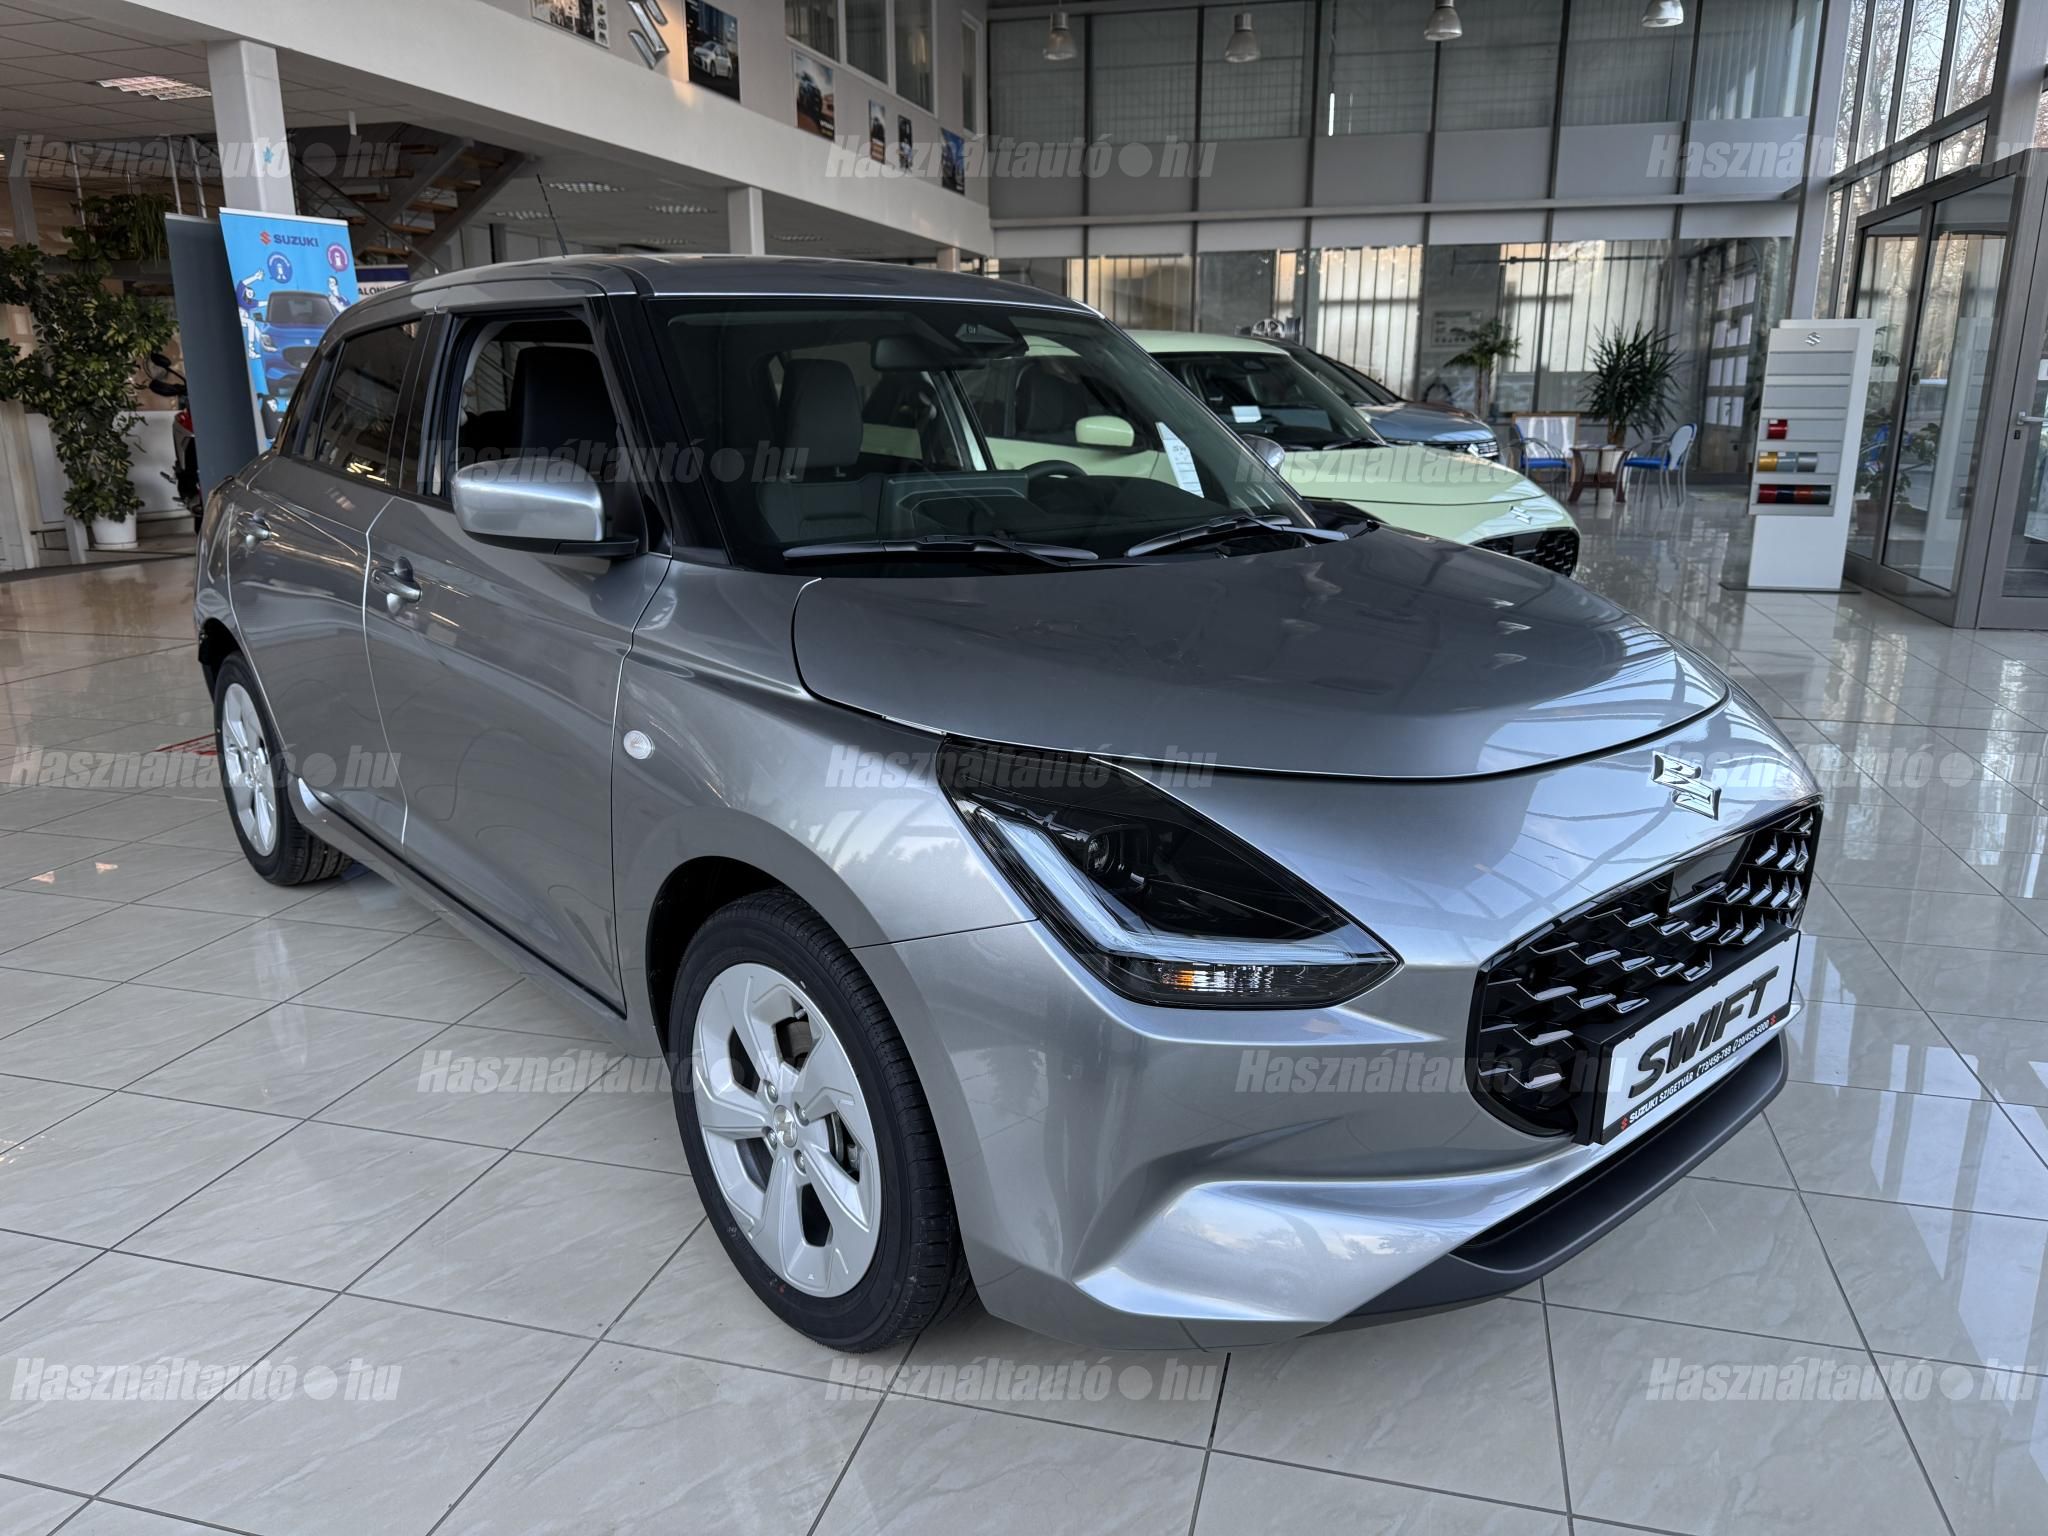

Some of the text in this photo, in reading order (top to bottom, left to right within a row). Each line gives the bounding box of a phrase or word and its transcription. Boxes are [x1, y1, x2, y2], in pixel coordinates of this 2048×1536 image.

[273, 233, 319, 248] SUZUKI
[1629, 965, 1779, 1098] SWIFT
[1629, 1096, 1658, 1123] SUZUKI
[1660, 1072, 1693, 1101] SZIGETVÁR
